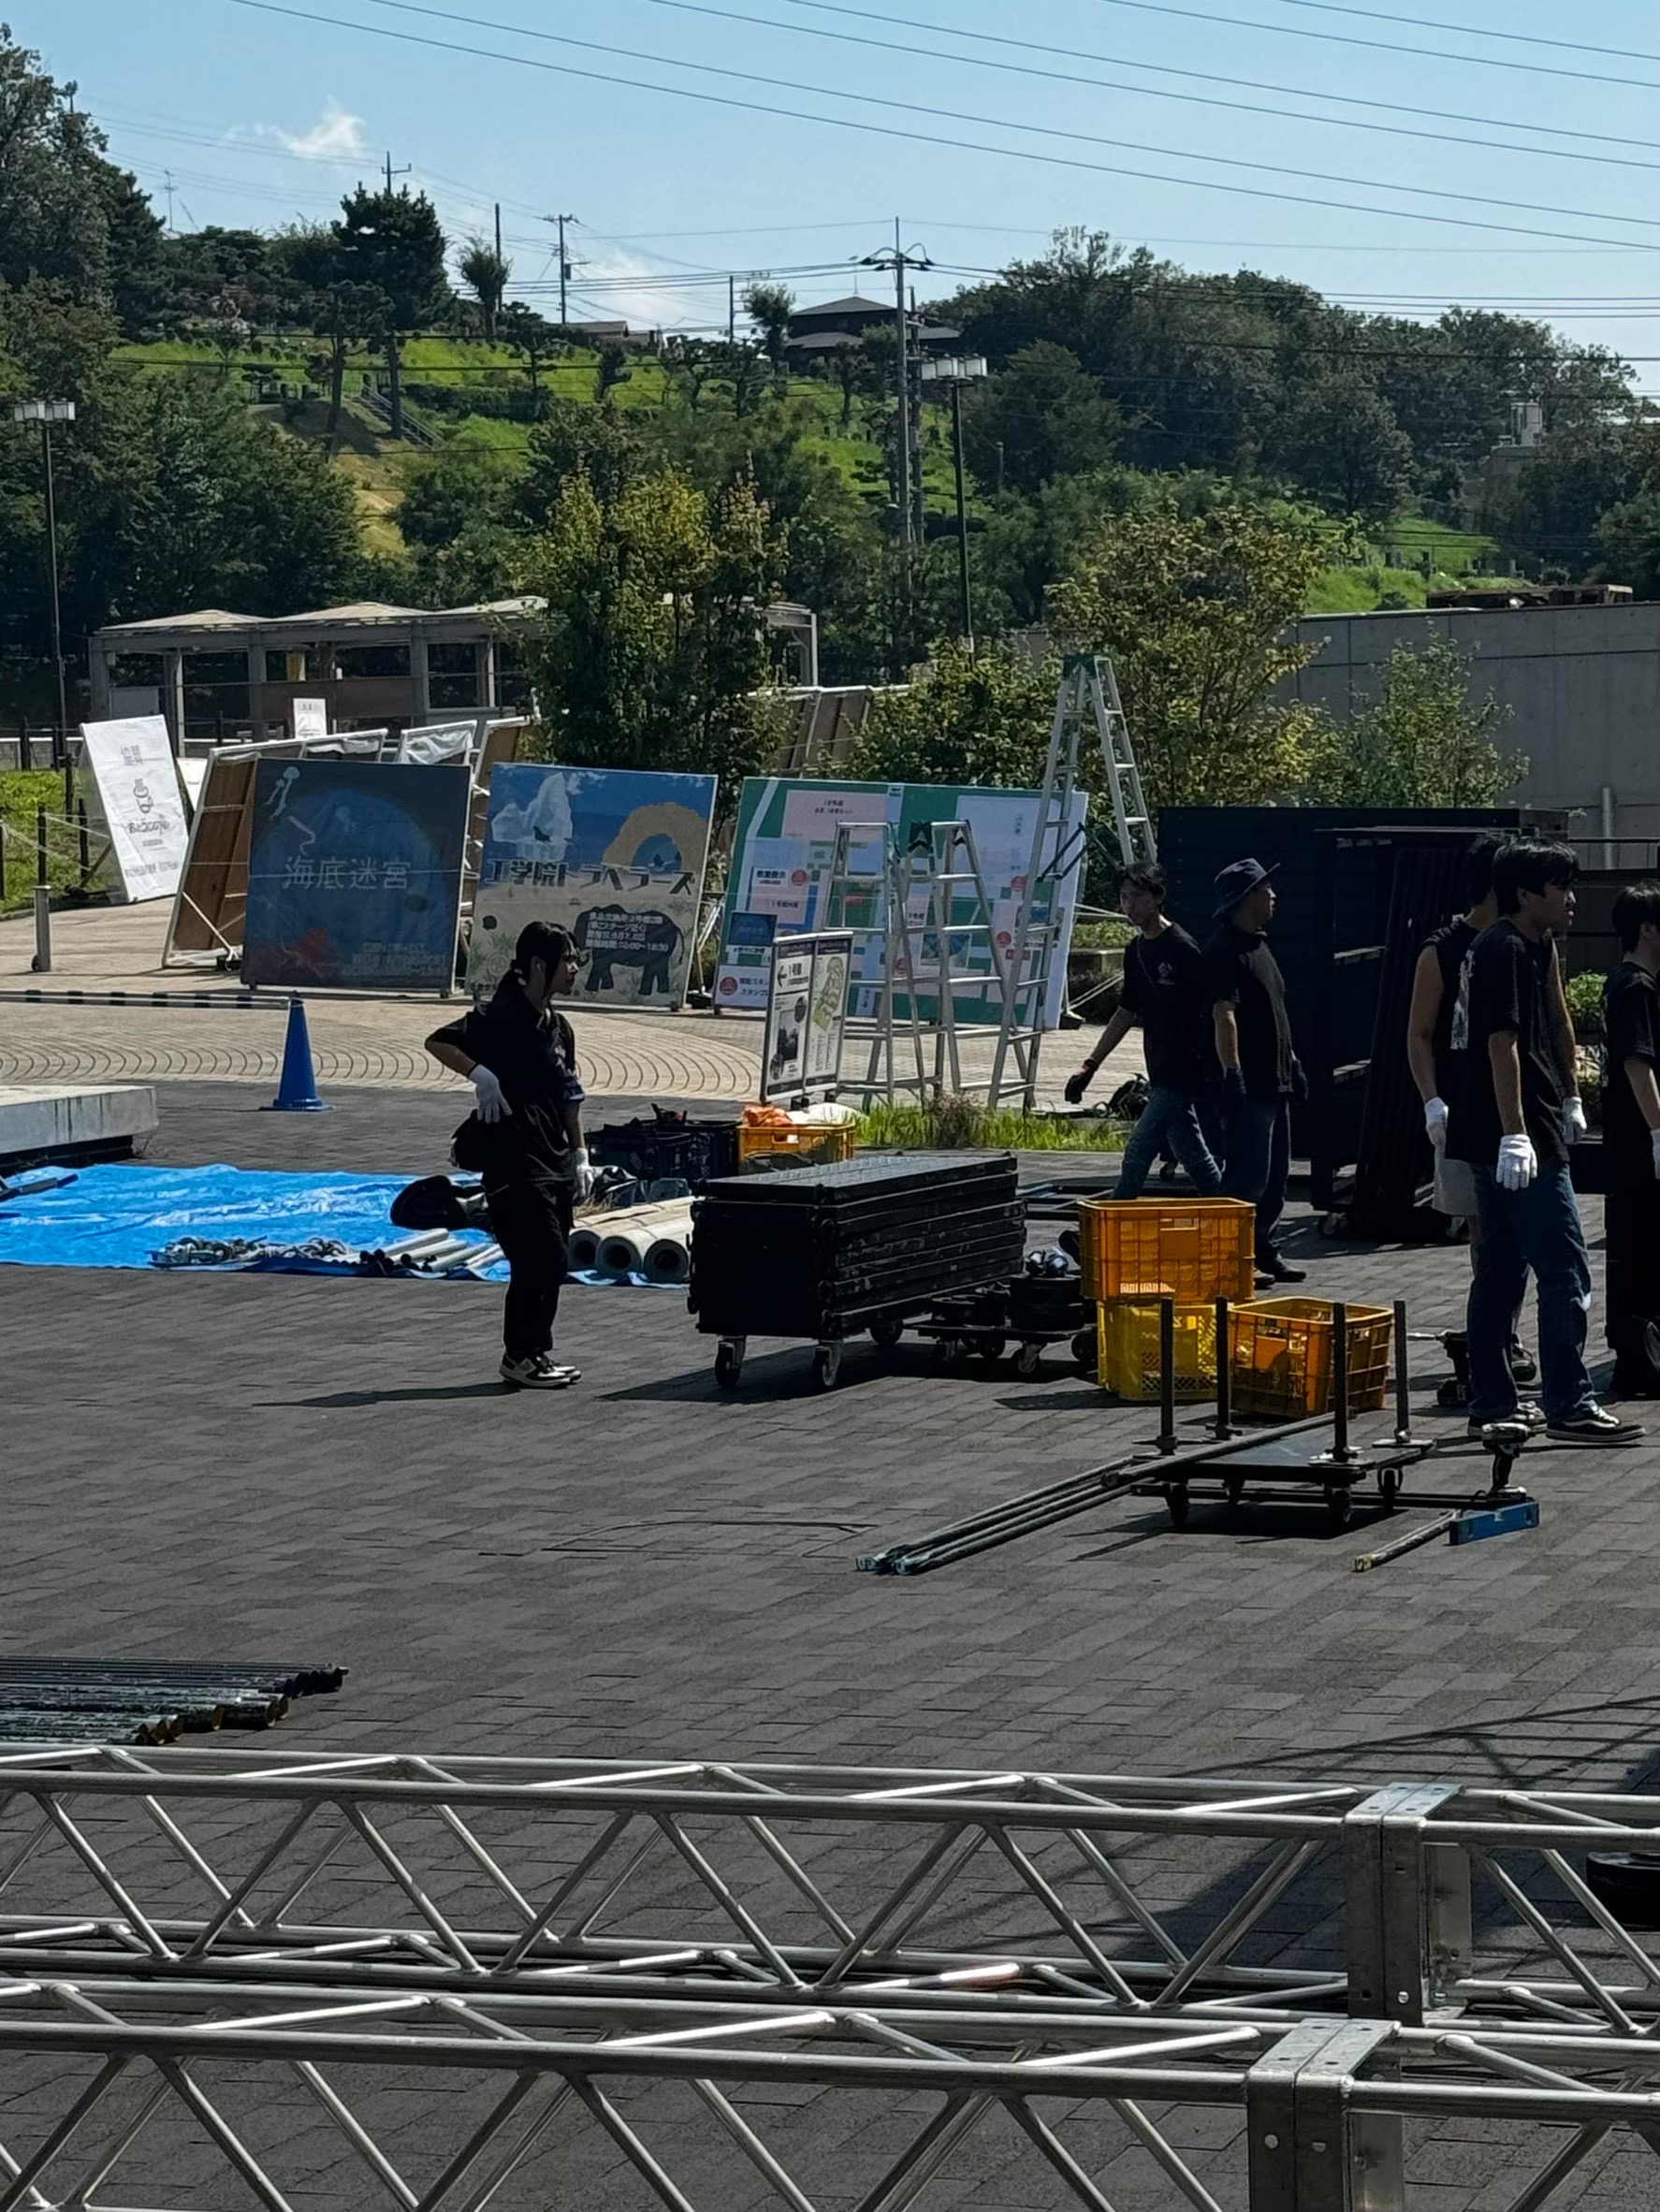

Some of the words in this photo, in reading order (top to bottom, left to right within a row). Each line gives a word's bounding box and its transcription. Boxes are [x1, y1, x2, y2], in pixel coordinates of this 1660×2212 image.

[282, 854, 412, 891] 海底迷宮
[484, 858, 696, 895] 工学院トラベラーズ
